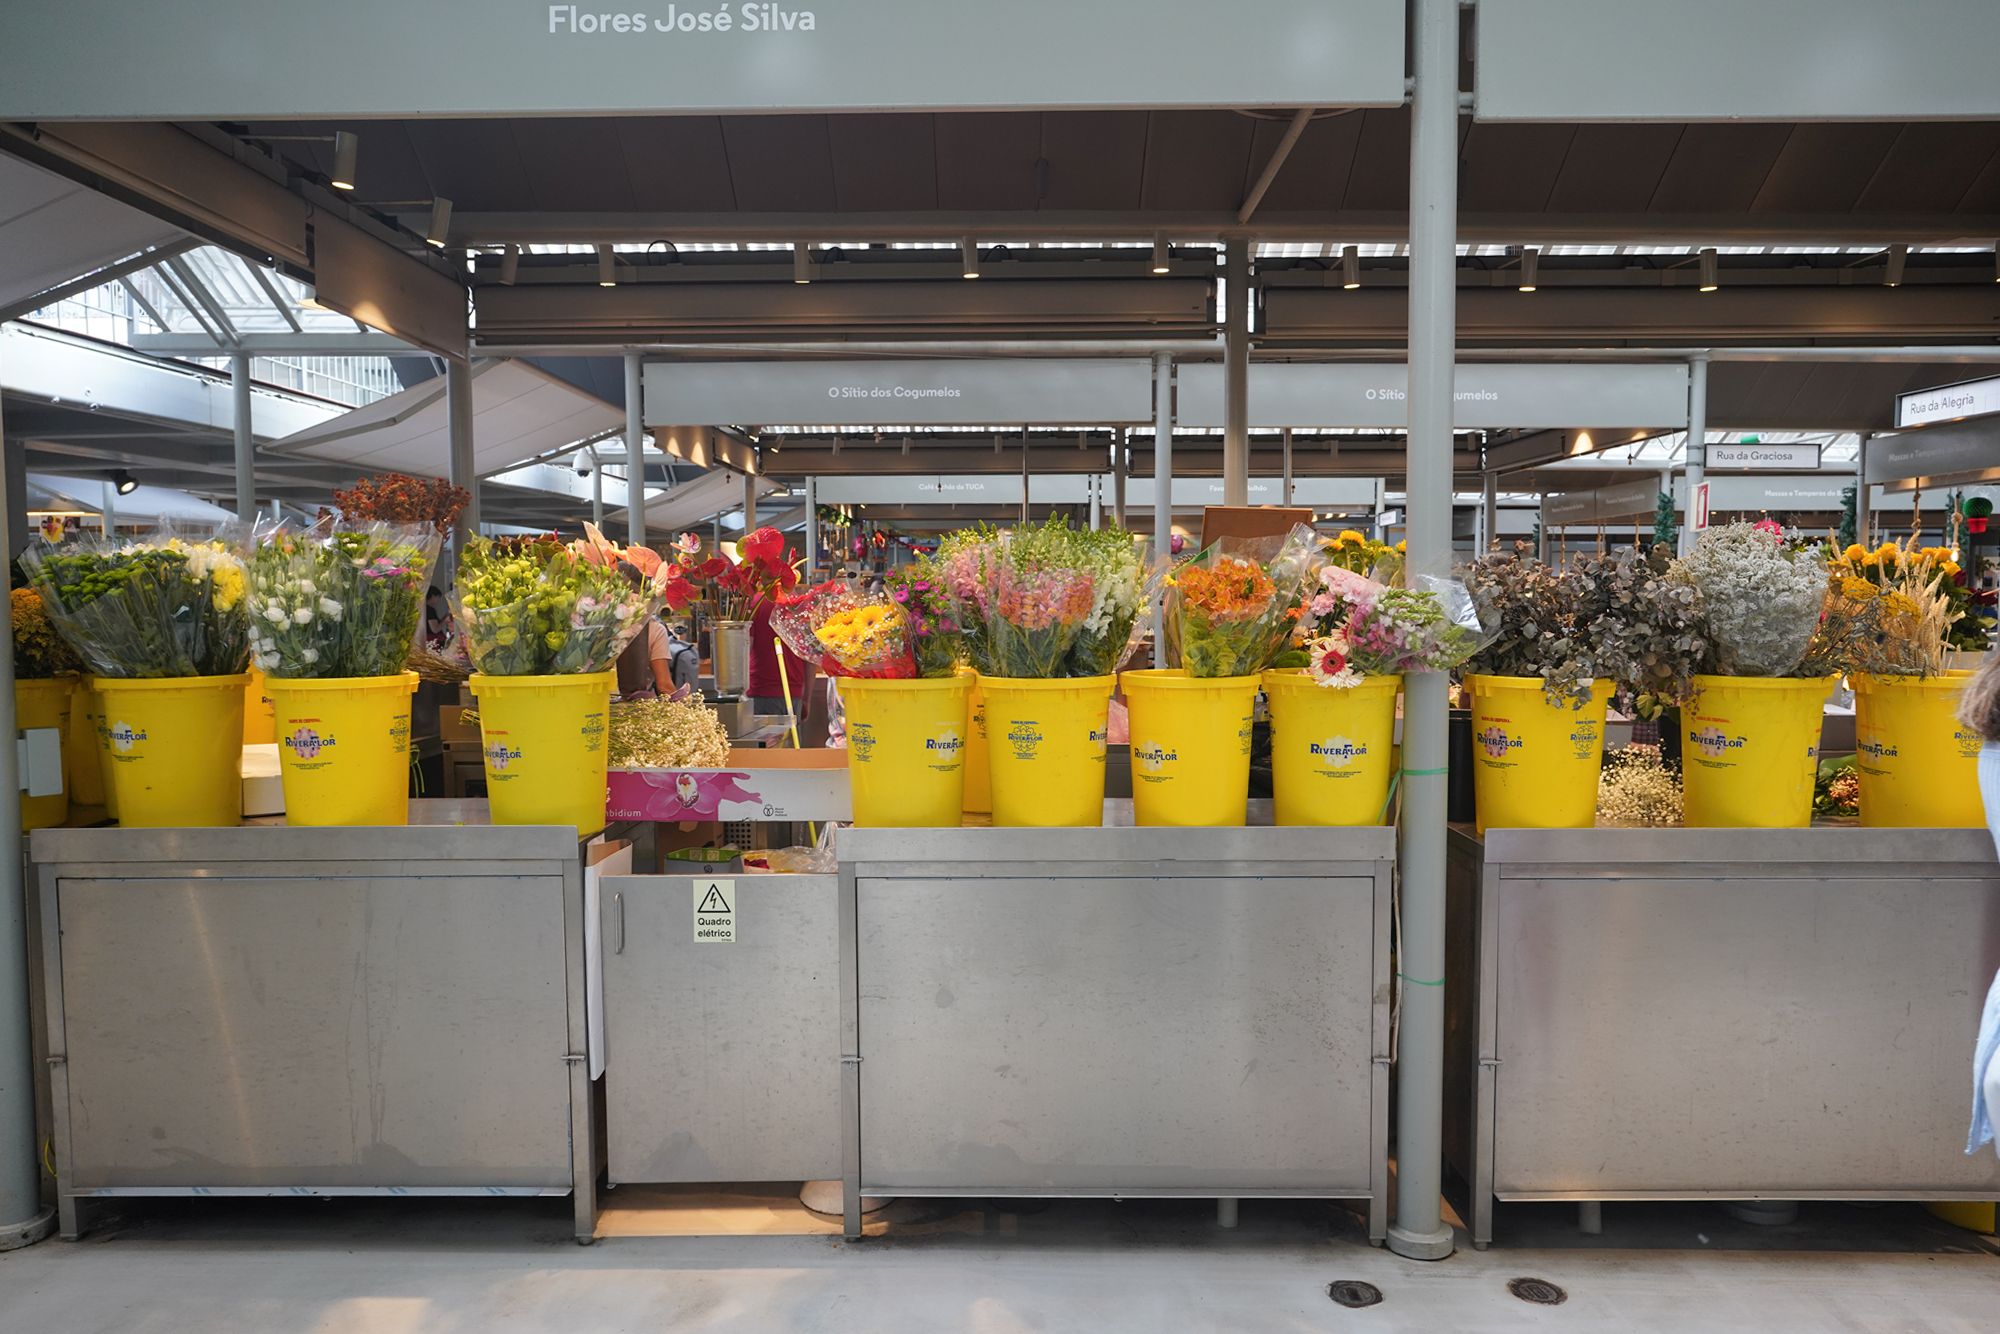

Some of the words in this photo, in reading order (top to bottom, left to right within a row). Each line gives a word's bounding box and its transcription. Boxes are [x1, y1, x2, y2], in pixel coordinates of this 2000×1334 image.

[549, 4, 648, 33] Flores
[653, 2, 733, 33] José
[740, 1, 816, 32] Silva
[828, 386, 840, 398] O
[841, 386, 868, 398] Sítio
[870, 386, 892, 398] dos
[893, 385, 961, 400] Cogumelos
[1365, 388, 1377, 400] O
[1379, 388, 1406, 400] Sítio
[1453, 388, 1499, 401] umelos
[1909, 402, 1926, 415] Rua
[1928, 399, 1940, 412] da
[1941, 392, 1975, 409] Alegria
[1716, 450, 1735, 460] Rua
[1736, 450, 1749, 460] da
[1750, 449, 1793, 460] Graciosa
[697, 917, 732, 926] Quadro
[697, 928, 732, 938] elétrico
